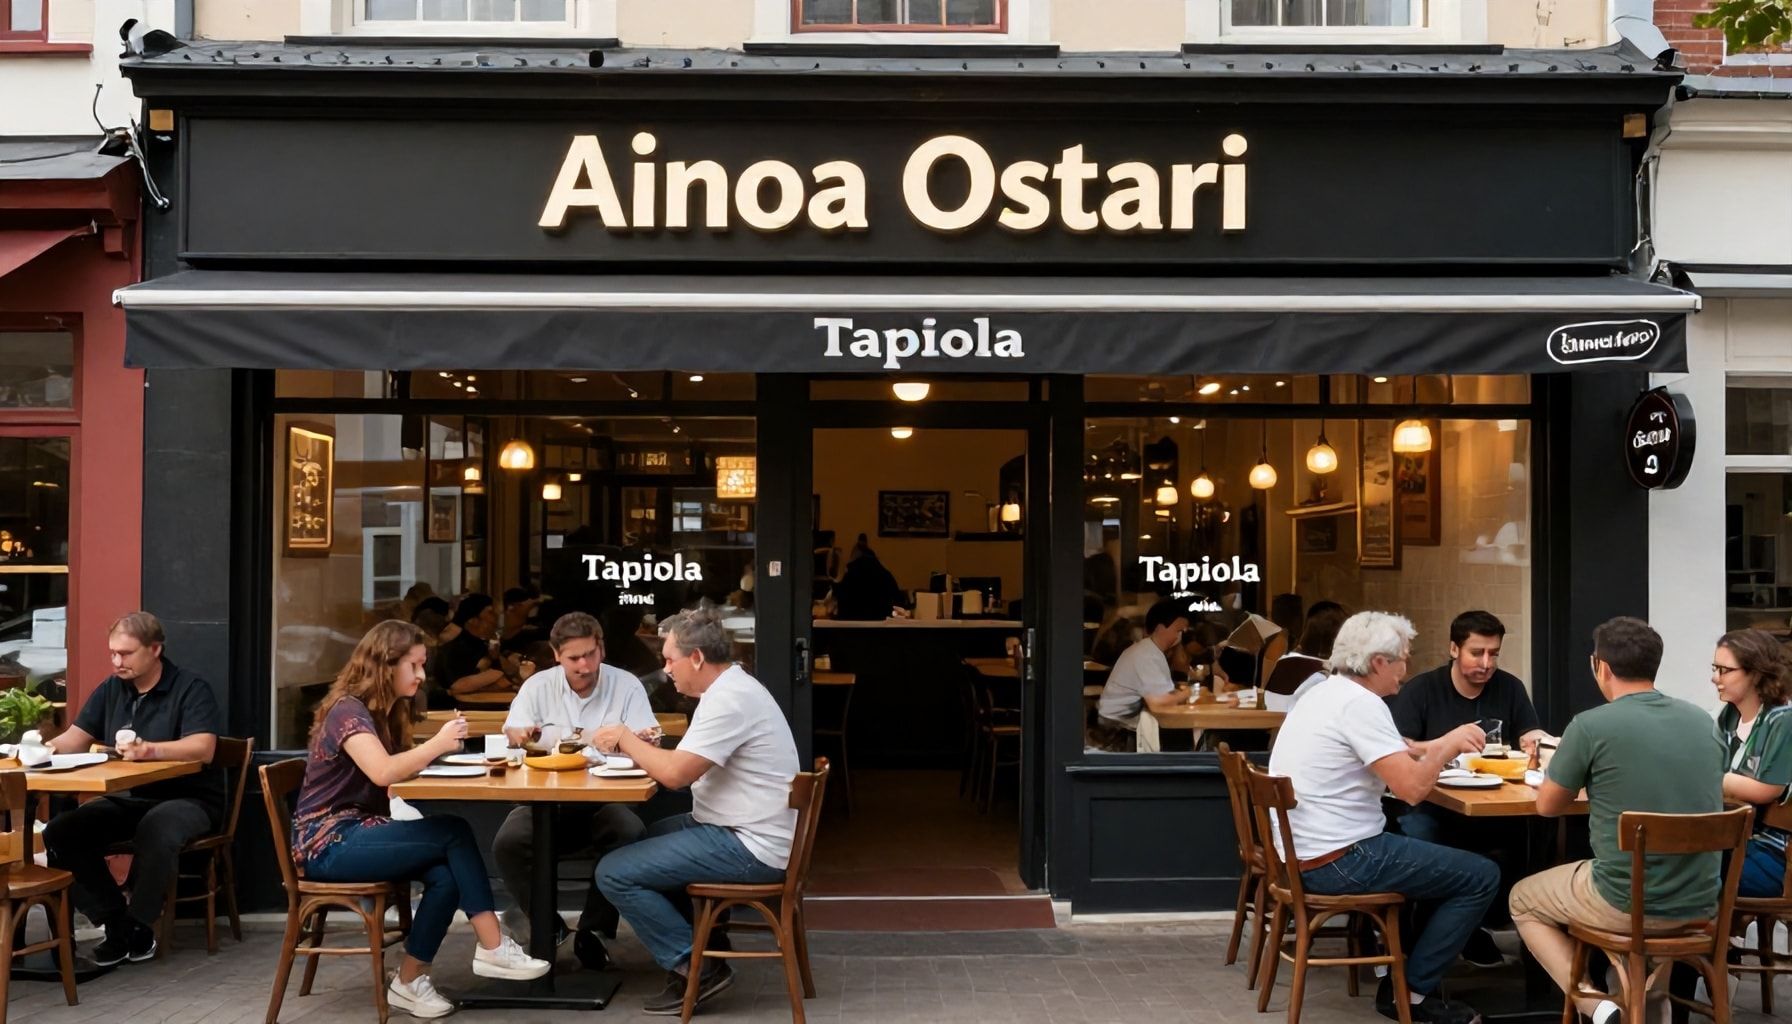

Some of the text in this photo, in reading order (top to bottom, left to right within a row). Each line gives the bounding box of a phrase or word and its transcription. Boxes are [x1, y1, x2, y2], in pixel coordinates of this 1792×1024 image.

[538, 132, 1247, 230] Ainoa Ostari
[814, 317, 1025, 370] Tapiola
[582, 553, 703, 588] Tapiola
[1139, 555, 1260, 590] Tapiola
